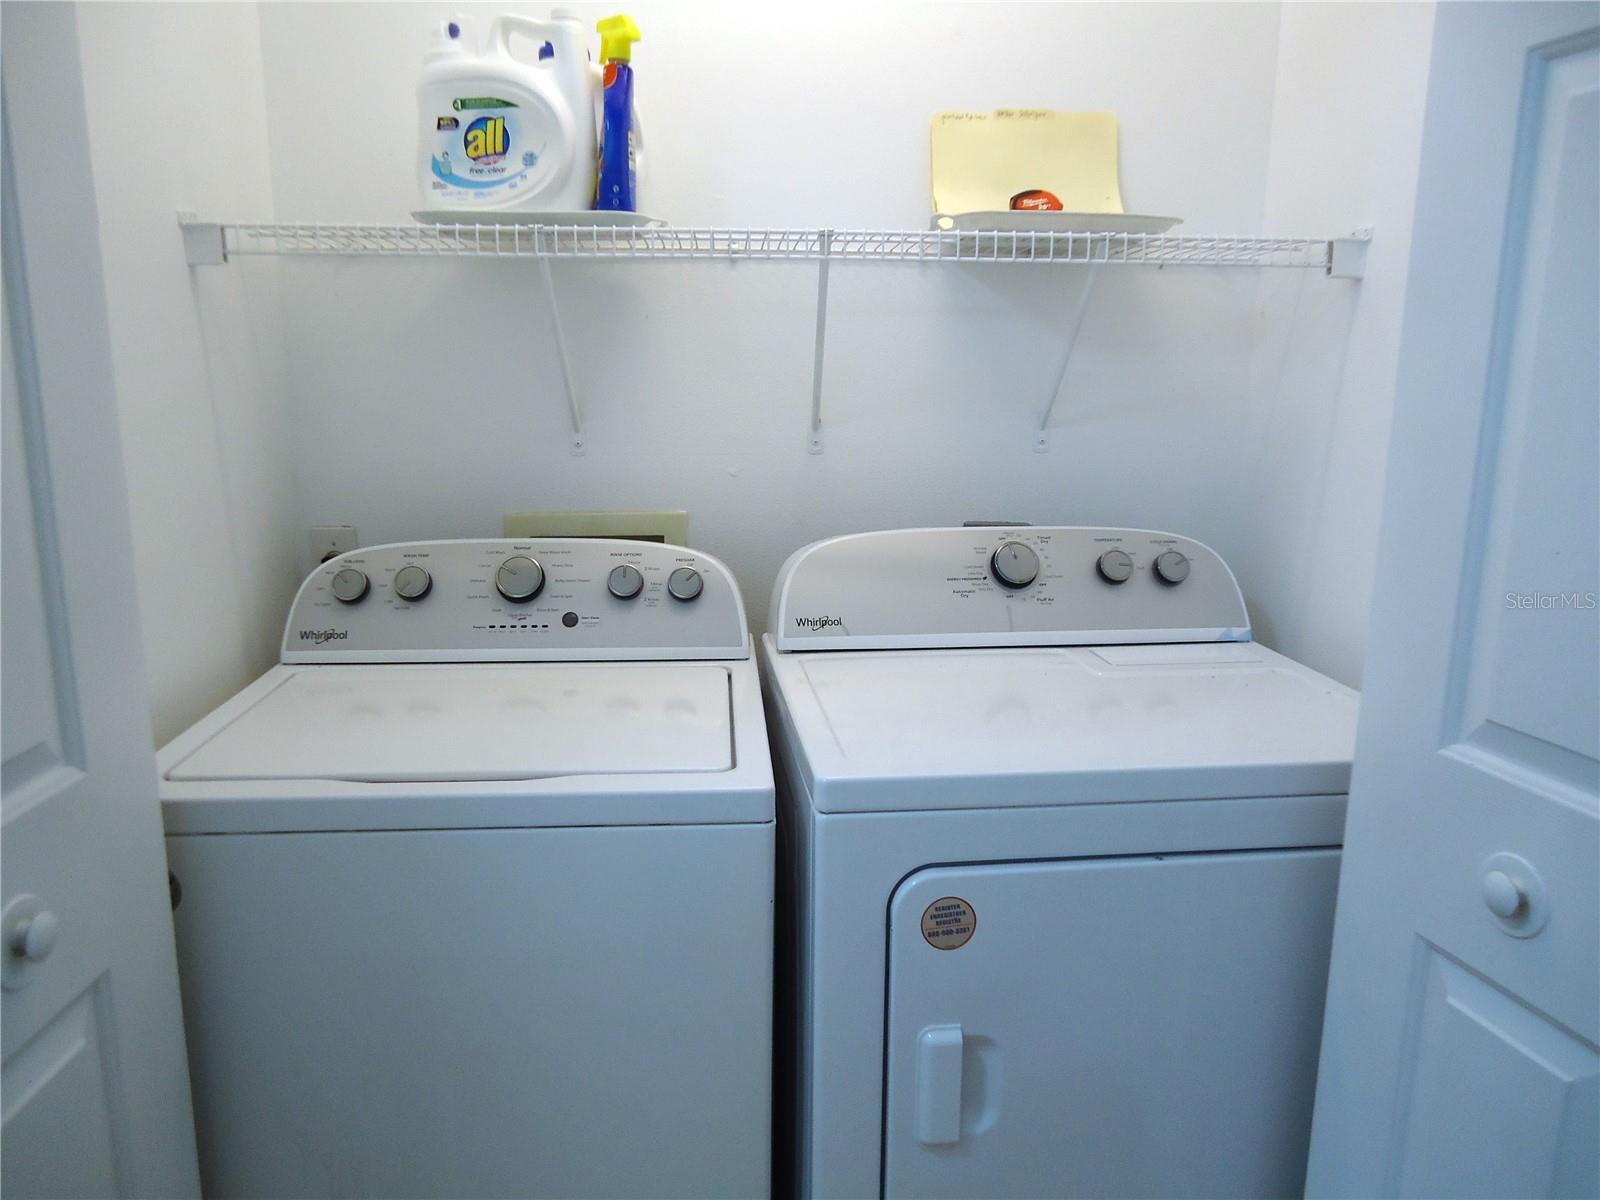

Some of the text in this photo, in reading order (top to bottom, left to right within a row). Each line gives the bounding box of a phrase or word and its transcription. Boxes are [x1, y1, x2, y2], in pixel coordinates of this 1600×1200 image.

[466, 117, 505, 159] all
[795, 616, 842, 631] Whirlpool
[299, 629, 348, 644] Whirlpool
